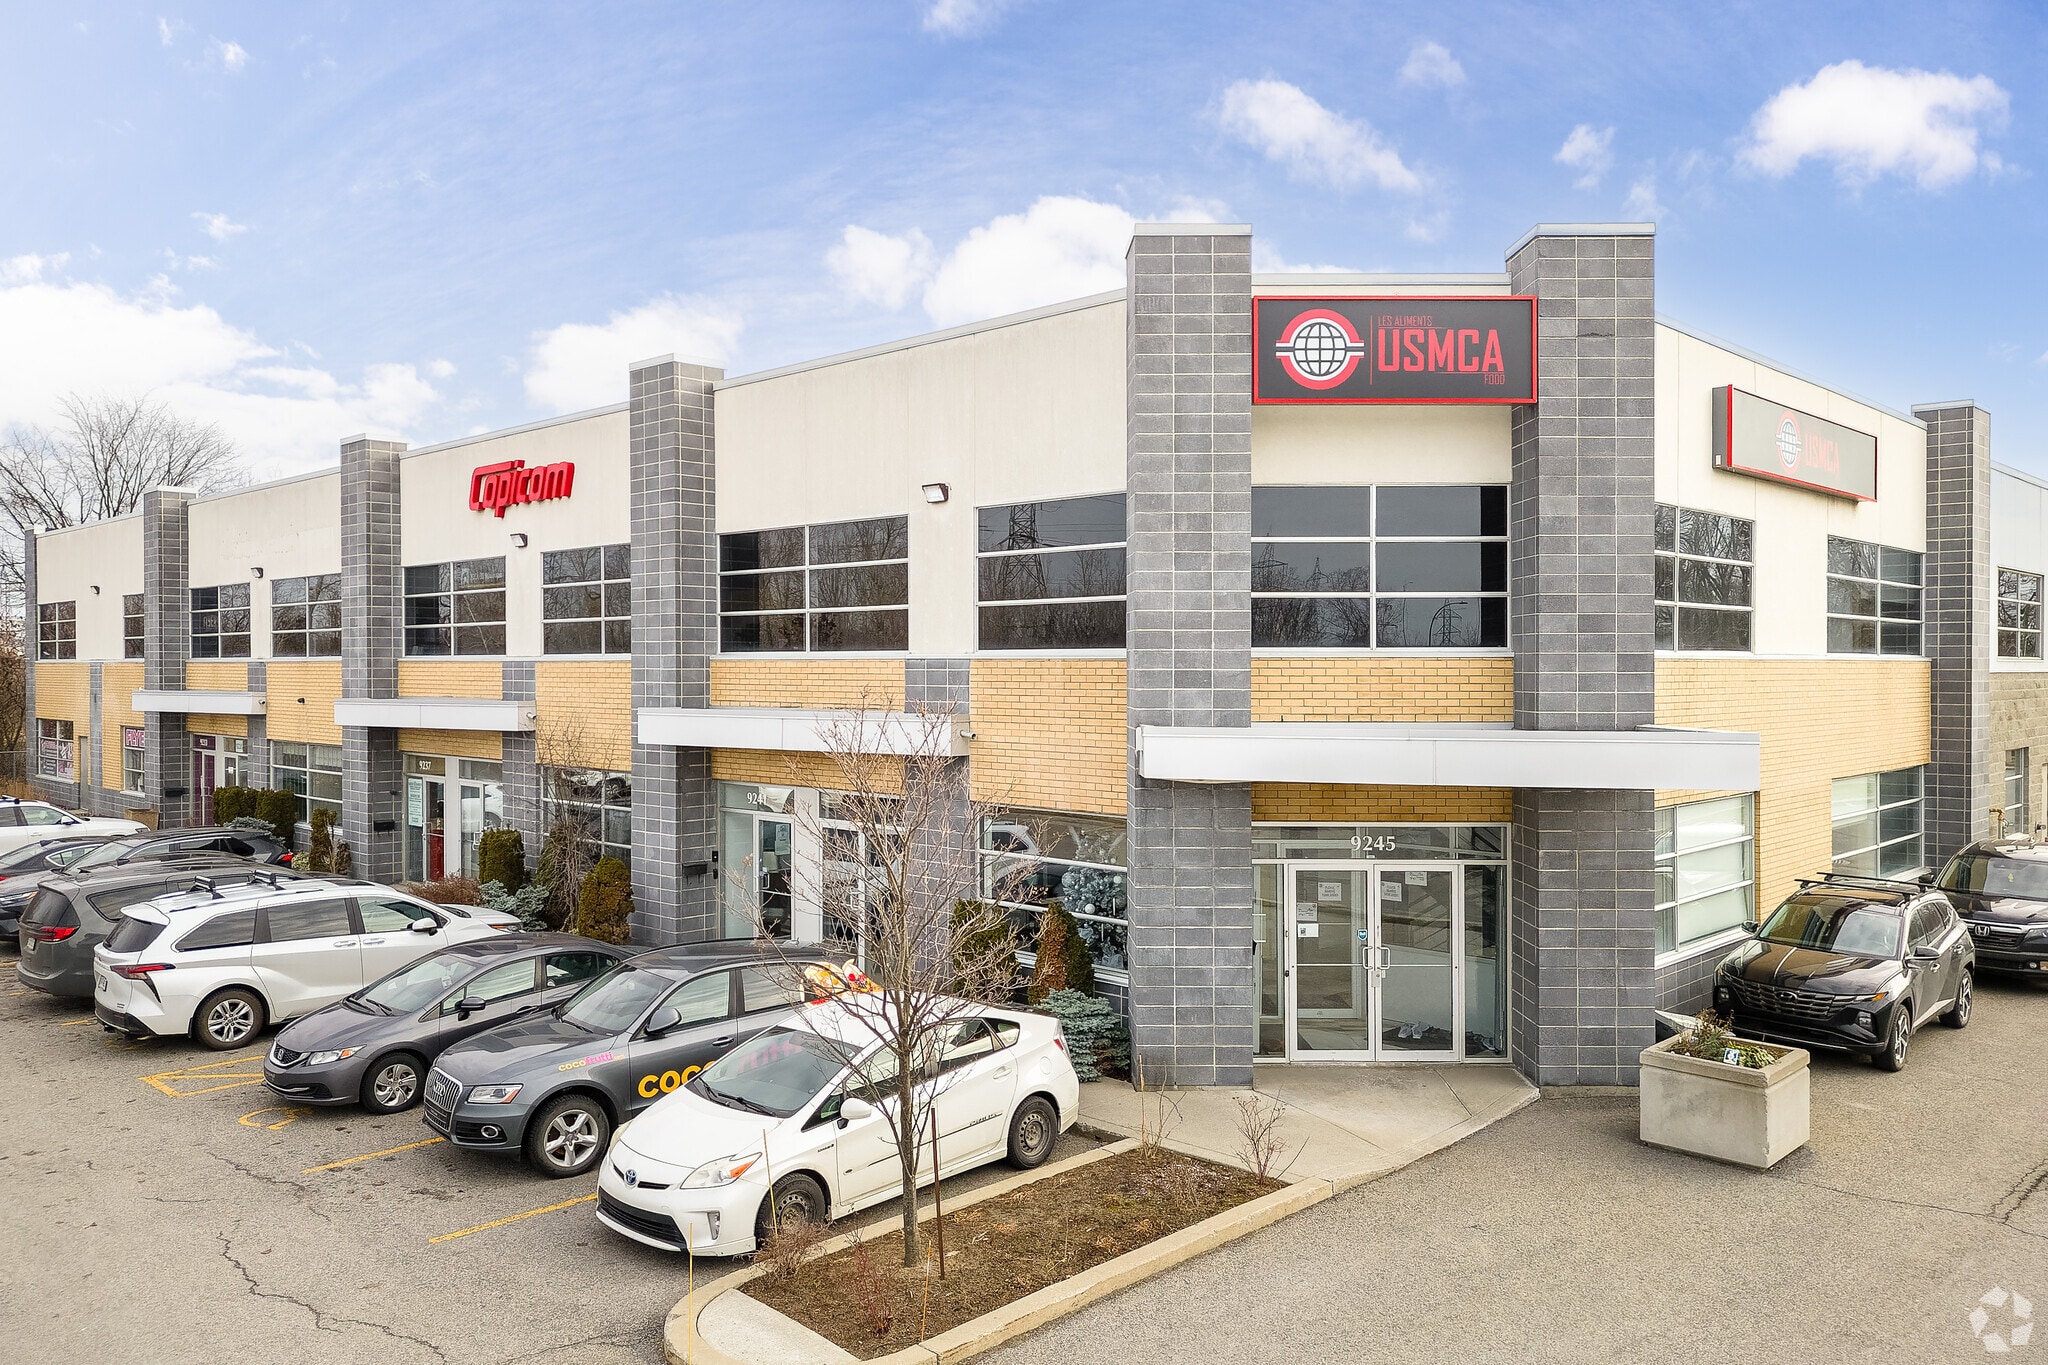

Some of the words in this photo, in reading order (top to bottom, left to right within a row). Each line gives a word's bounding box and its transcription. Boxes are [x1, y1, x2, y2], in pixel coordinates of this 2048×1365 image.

[1377, 315, 1393, 327] LES
[1394, 315, 1433, 327] ALIMENTS
[1377, 328, 1505, 372] USMCA
[1484, 373, 1506, 385] FOOD
[1804, 431, 1840, 474] USMCA
[469, 459, 575, 519] Copicom
[419, 760, 431, 770] 9237
[746, 792, 767, 805] 9241
[1350, 835, 1396, 852] 9245
